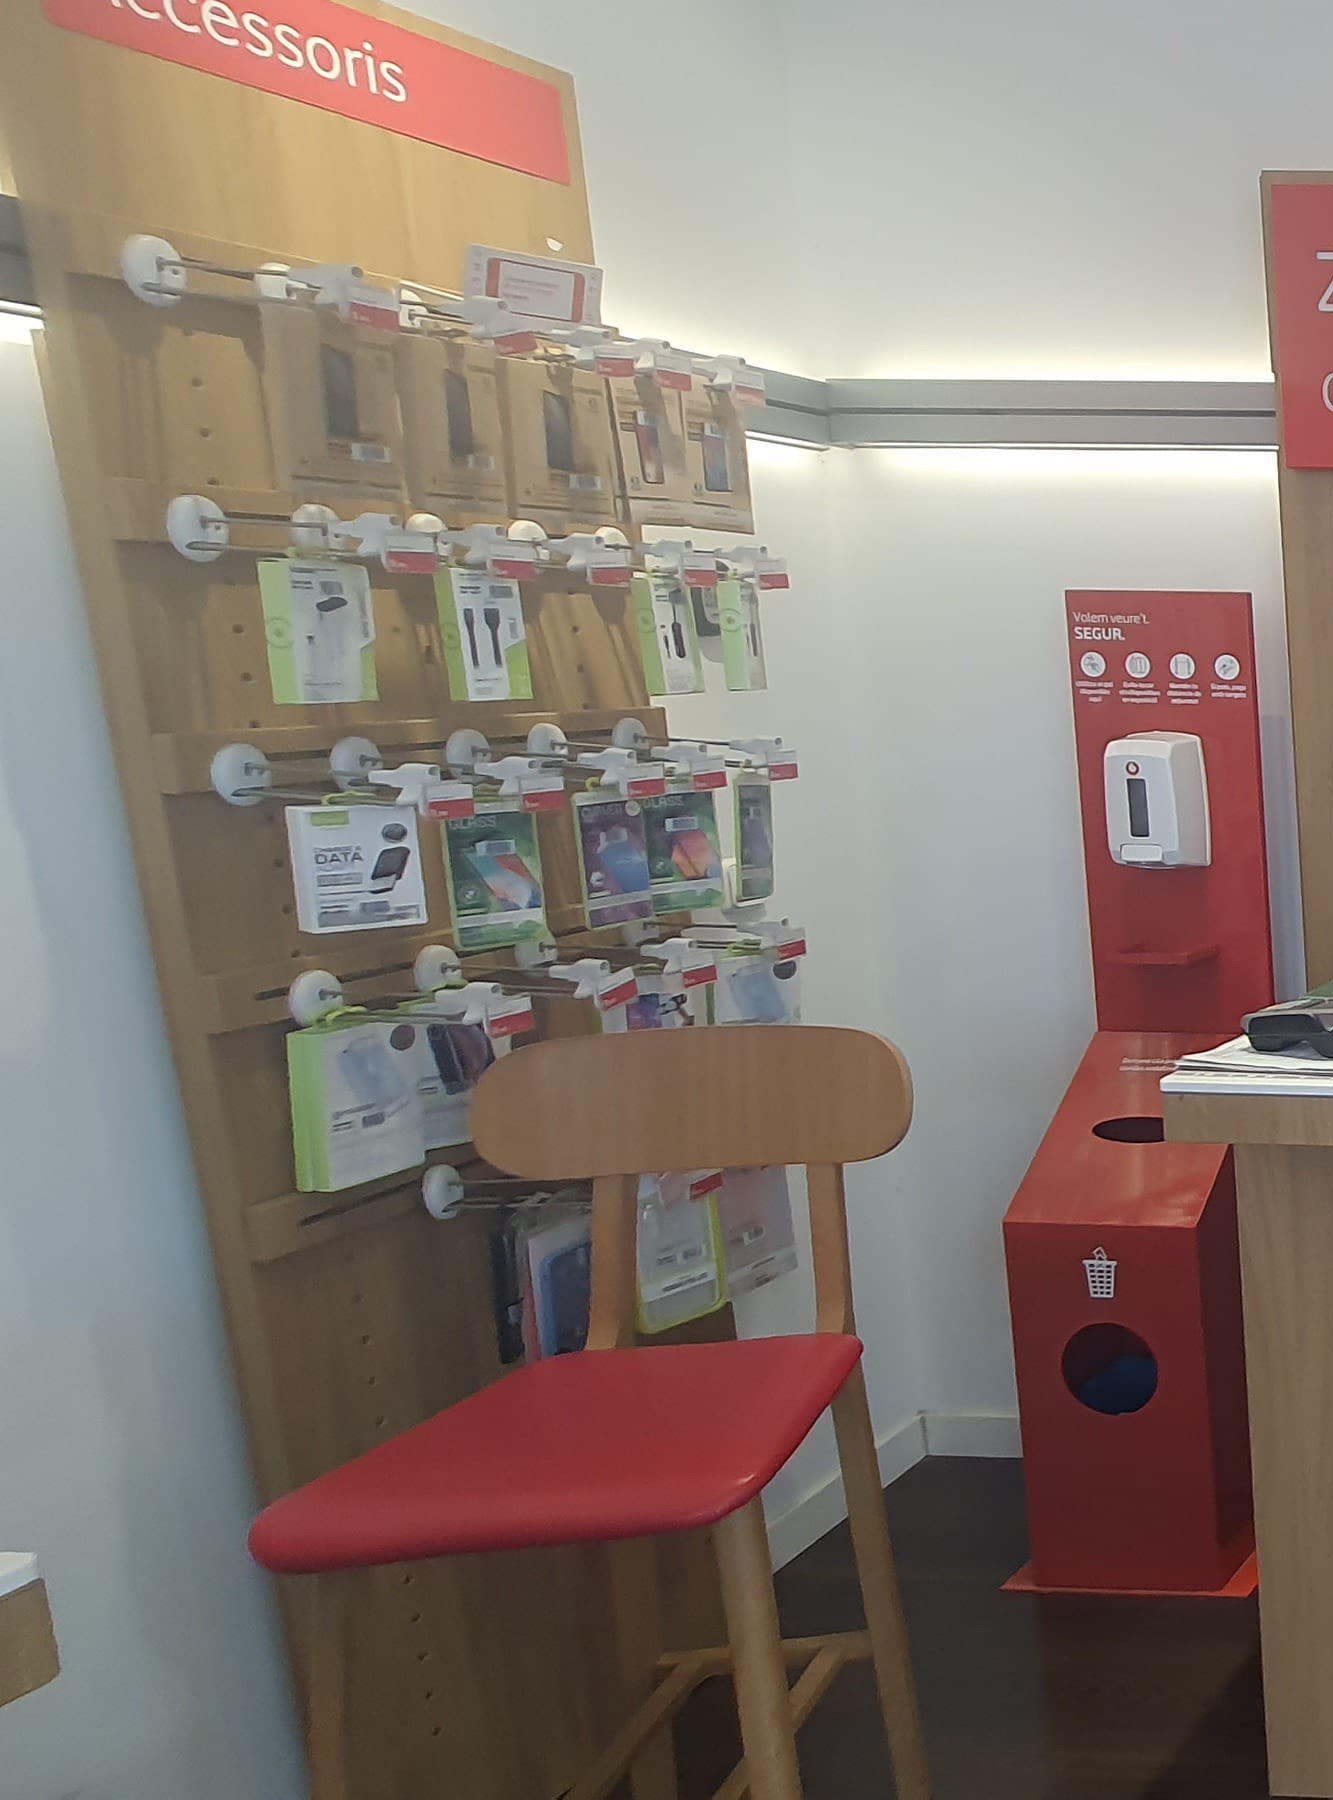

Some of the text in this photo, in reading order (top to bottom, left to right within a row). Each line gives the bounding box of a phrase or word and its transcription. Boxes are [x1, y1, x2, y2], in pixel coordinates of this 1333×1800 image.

[108, 0, 408, 103] cessoris
[1073, 612, 1109, 624] Volem
[1074, 626, 1126, 641] SEGUR.
[314, 850, 364, 867] DATA
